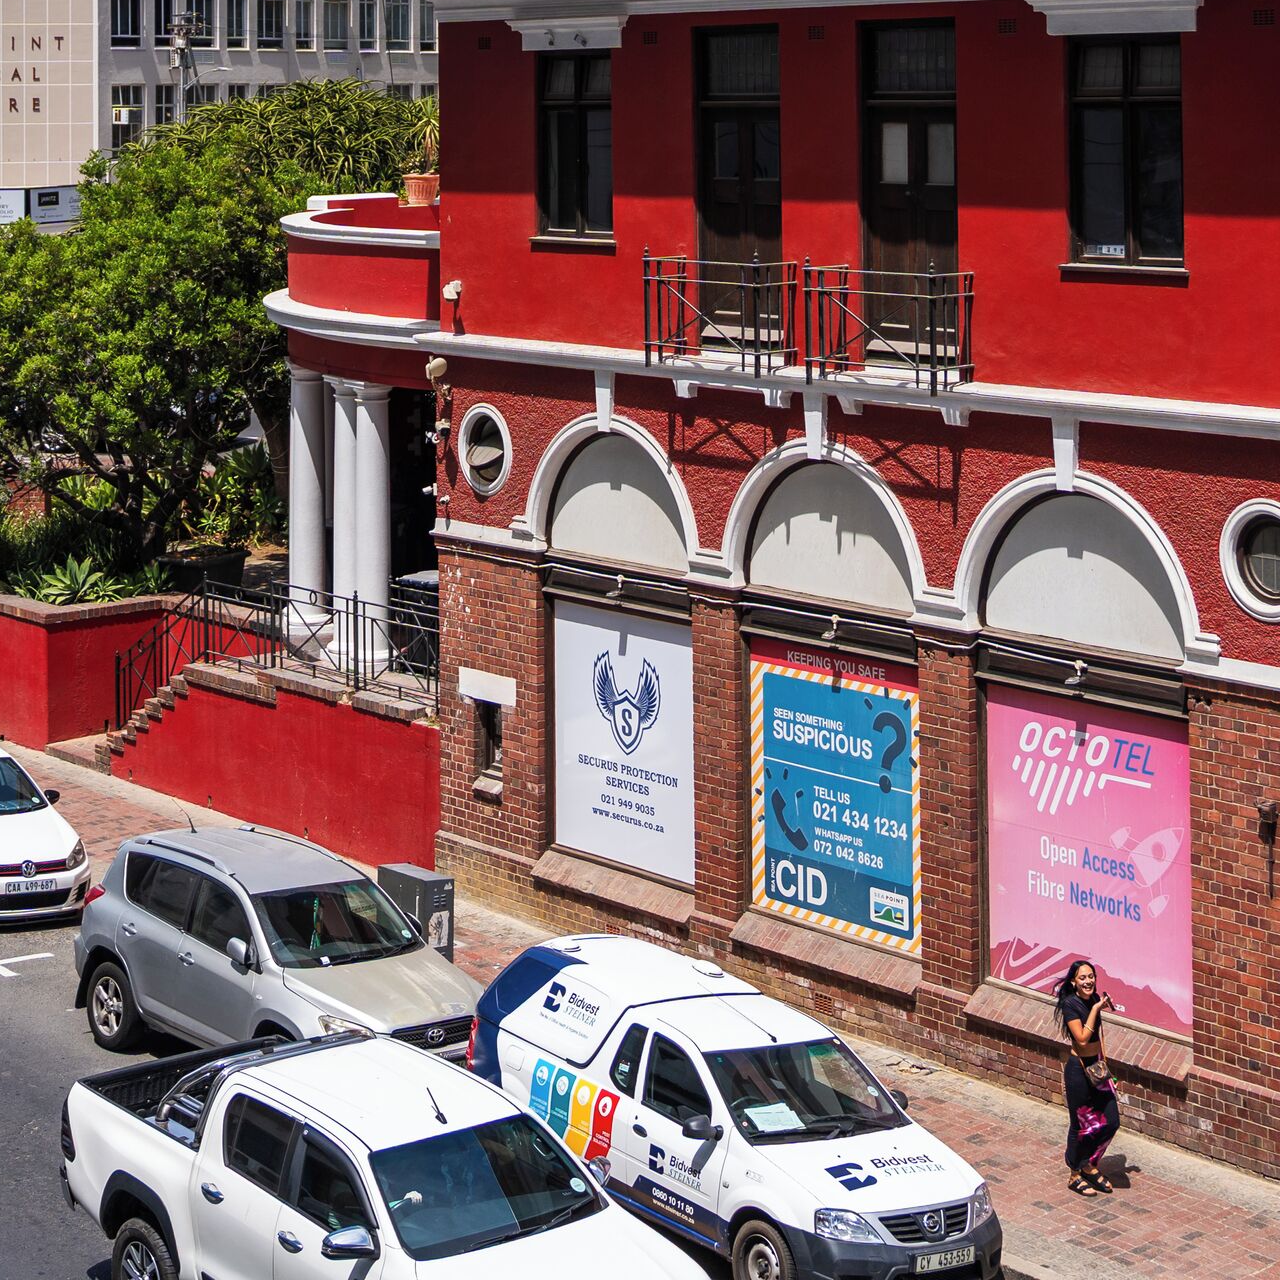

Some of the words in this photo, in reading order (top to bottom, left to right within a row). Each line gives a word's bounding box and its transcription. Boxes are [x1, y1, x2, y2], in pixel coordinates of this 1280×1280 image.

[787, 650, 831, 670] KEEPING
[833, 658, 856, 675] YOU
[858, 664, 886, 681] SAFE
[621, 708, 633, 737] S
[773, 707, 794, 721] SEEN
[795, 711, 843, 732] SOMETHING
[772, 720, 873, 760] SUSPICIOUS
[1019, 721, 1155, 776] OCTOTEL
[578, 753, 619, 773] SECURUS
[620, 763, 678, 788] PROTECTION
[605, 776, 650, 796] SERVICES
[813, 785, 836, 802] TELL
[837, 792, 851, 805] US
[600, 793, 615, 806] 021
[617, 798, 633, 810] 949
[635, 802, 655, 817] 9035
[592, 806, 665, 834] www.securus.co.za
[813, 801, 837, 823] 021
[842, 808, 869, 831] 434
[874, 816, 908, 841] 1234
[814, 826, 853, 844] WHATSAPP
[853, 837, 863, 847] US
[813, 839, 832, 856] 072
[835, 845, 855, 862] 042
[857, 851, 884, 870] 8626
[1040, 835, 1077, 867] Open
[1082, 847, 1136, 882] Access
[7, 883, 20, 893] CAA
[775, 859, 828, 906] CID
[873, 892, 885, 901] SEA
[885, 895, 904, 905] POINT
[1027, 870, 1065, 902] Fibre
[1070, 881, 1141, 922] Networks
[563, 1005, 597, 1027] STEINER
[567, 992, 600, 1016] Bidvest
[669, 1155, 702, 1180] Bidvest
[870, 1153, 934, 1169] Bidvest
[883, 1163, 946, 1178] STEINER
[668, 1168, 702, 1192] STEINER
[668, 1196, 676, 1206] 10
[677, 1200, 685, 1211] 11
[920, 1255, 932, 1271] CY
[938, 1248, 971, 1267] 453-559
